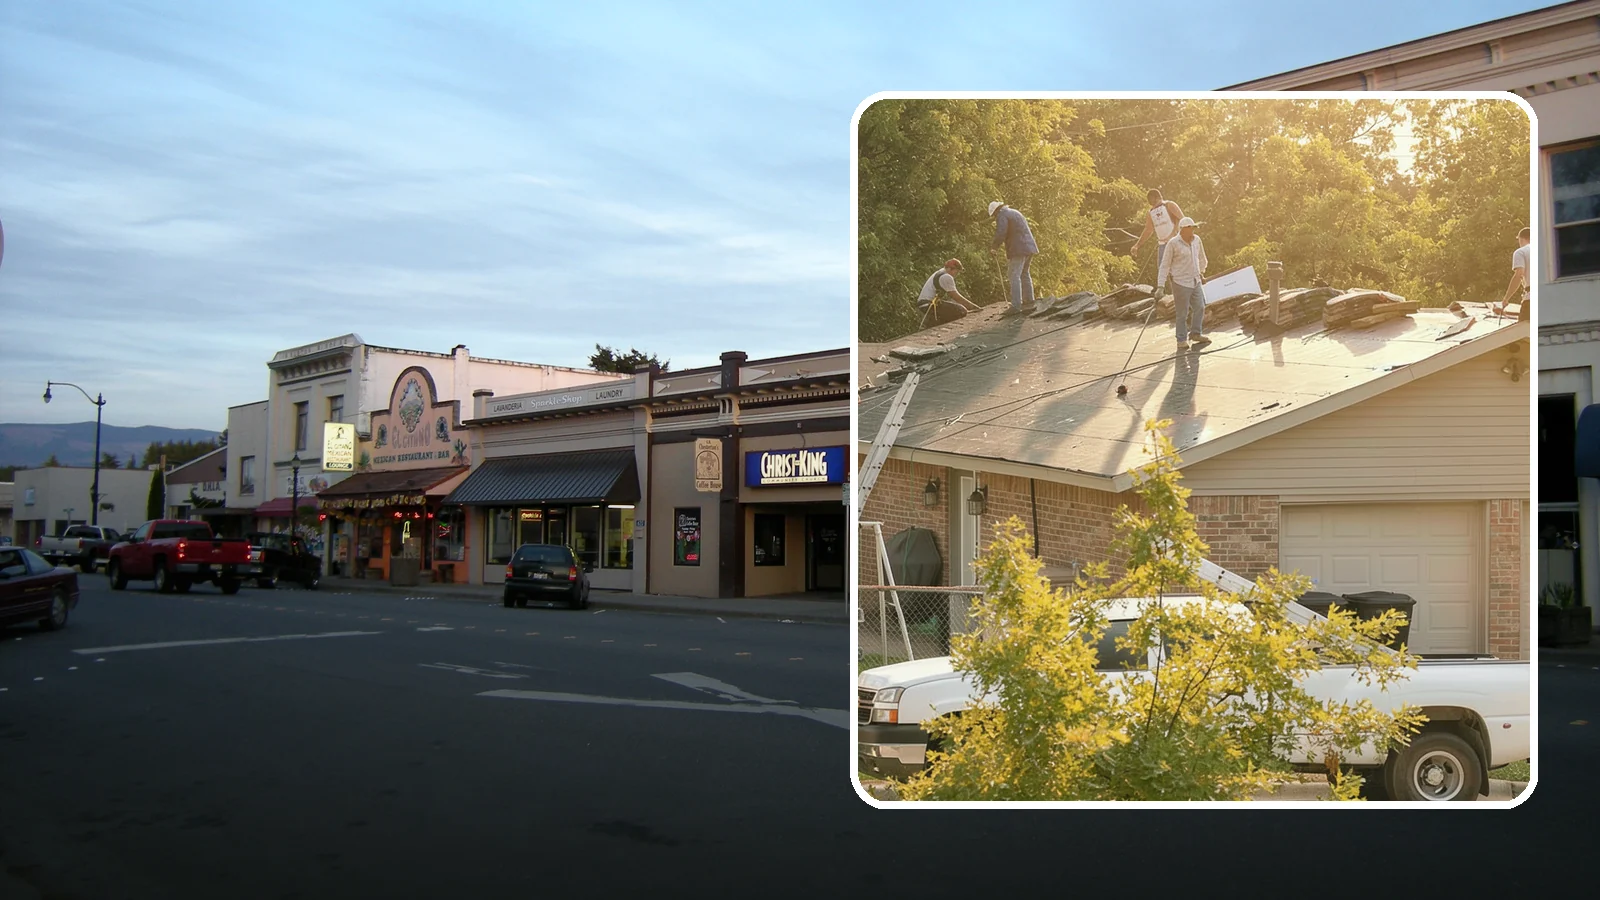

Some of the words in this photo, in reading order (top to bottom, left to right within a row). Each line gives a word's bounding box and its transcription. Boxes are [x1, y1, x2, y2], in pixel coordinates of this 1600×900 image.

[561, 394, 582, 404] Shop
[596, 389, 623, 399] LAUNDRY
[493, 402, 522, 412] LAVANDERIA
[392, 426, 401, 449] EL
[334, 441, 352, 450] GITANO
[374, 455, 396, 464] MEXICAN
[397, 452, 433, 462] RESTAURANT
[438, 450, 450, 458] BAR
[761, 452, 797, 478] CHRIST
[799, 450, 827, 476] KING
[697, 481, 709, 489] Coffee
[710, 481, 721, 489] House
